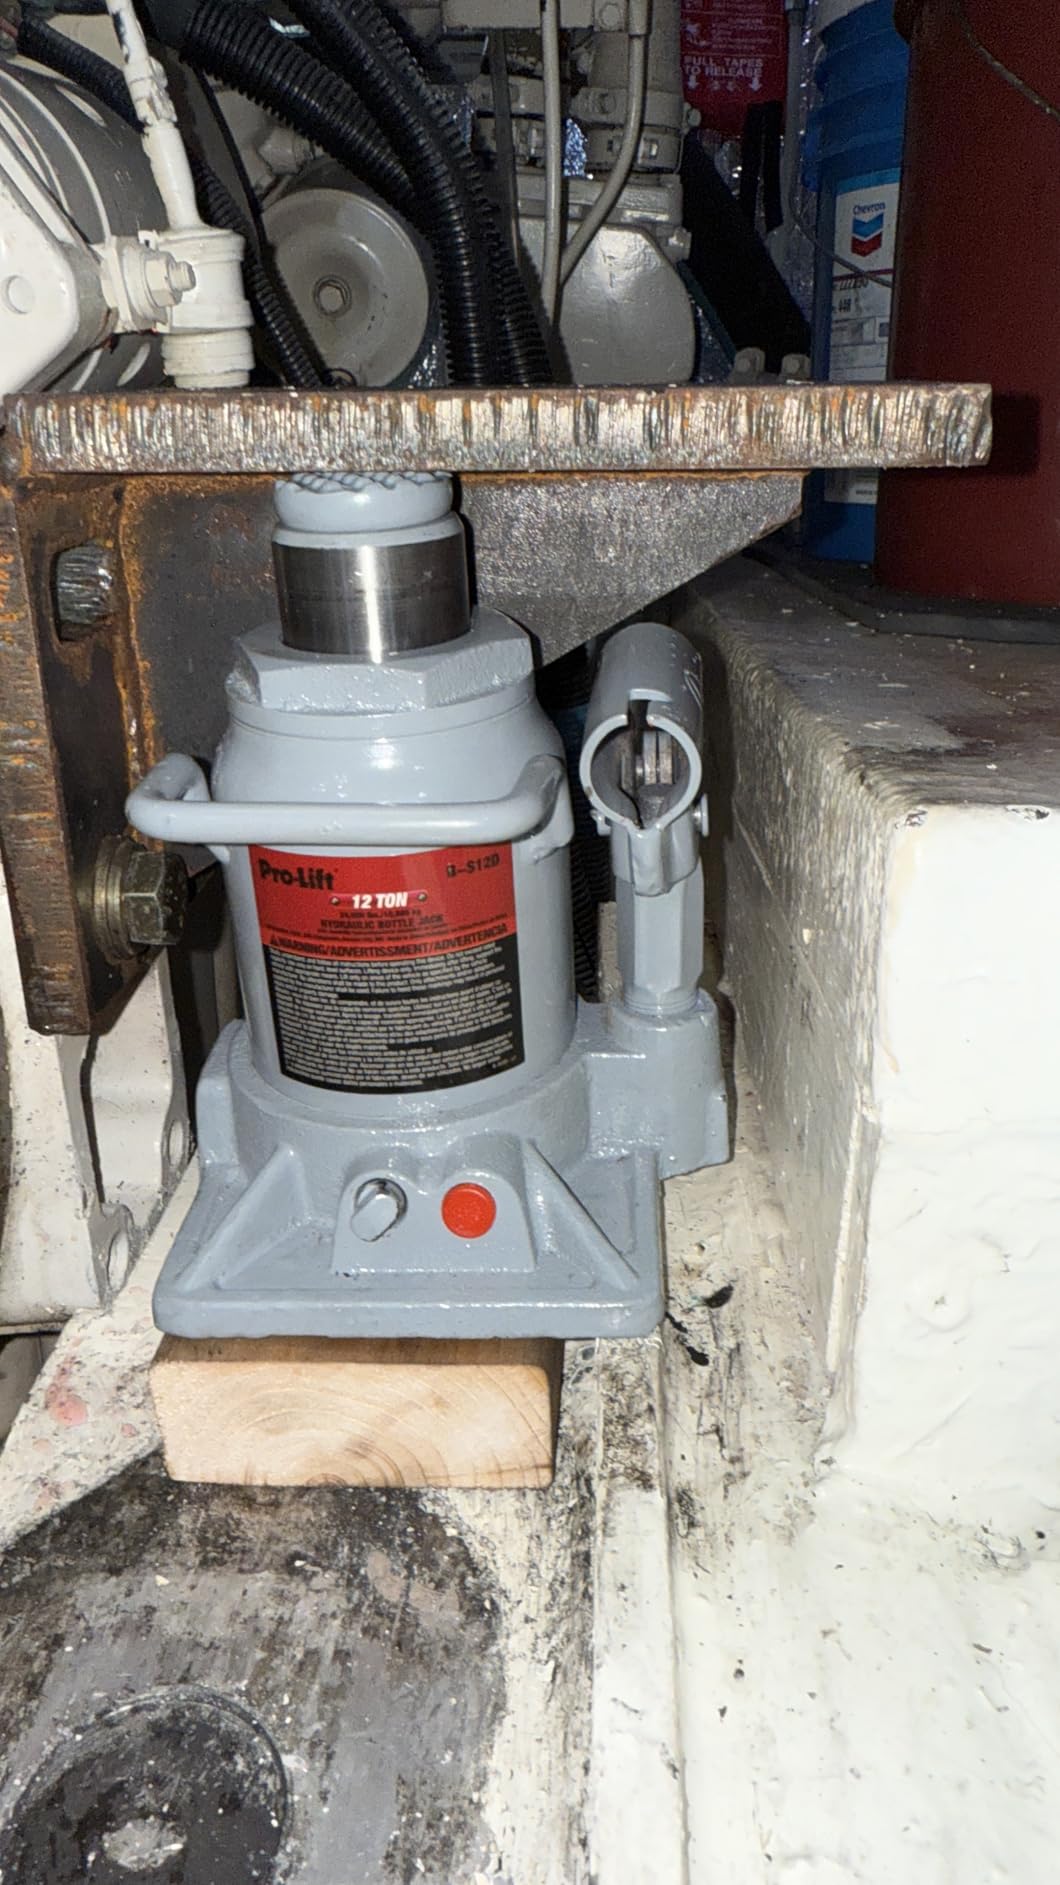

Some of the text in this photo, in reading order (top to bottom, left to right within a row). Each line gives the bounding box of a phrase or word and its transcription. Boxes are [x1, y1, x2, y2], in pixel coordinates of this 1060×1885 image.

[723, 58, 763, 69] TAPES
[684, 65, 763, 78] TO RELEASE
[852, 202, 886, 216] Chevron
[258, 857, 334, 890] Pro-Lift
[352, 891, 409, 909] 12 TON
[320, 919, 375, 930] HYDRAULIC
[378, 917, 414, 929] BOTTLE
[419, 913, 444, 925] JACK
